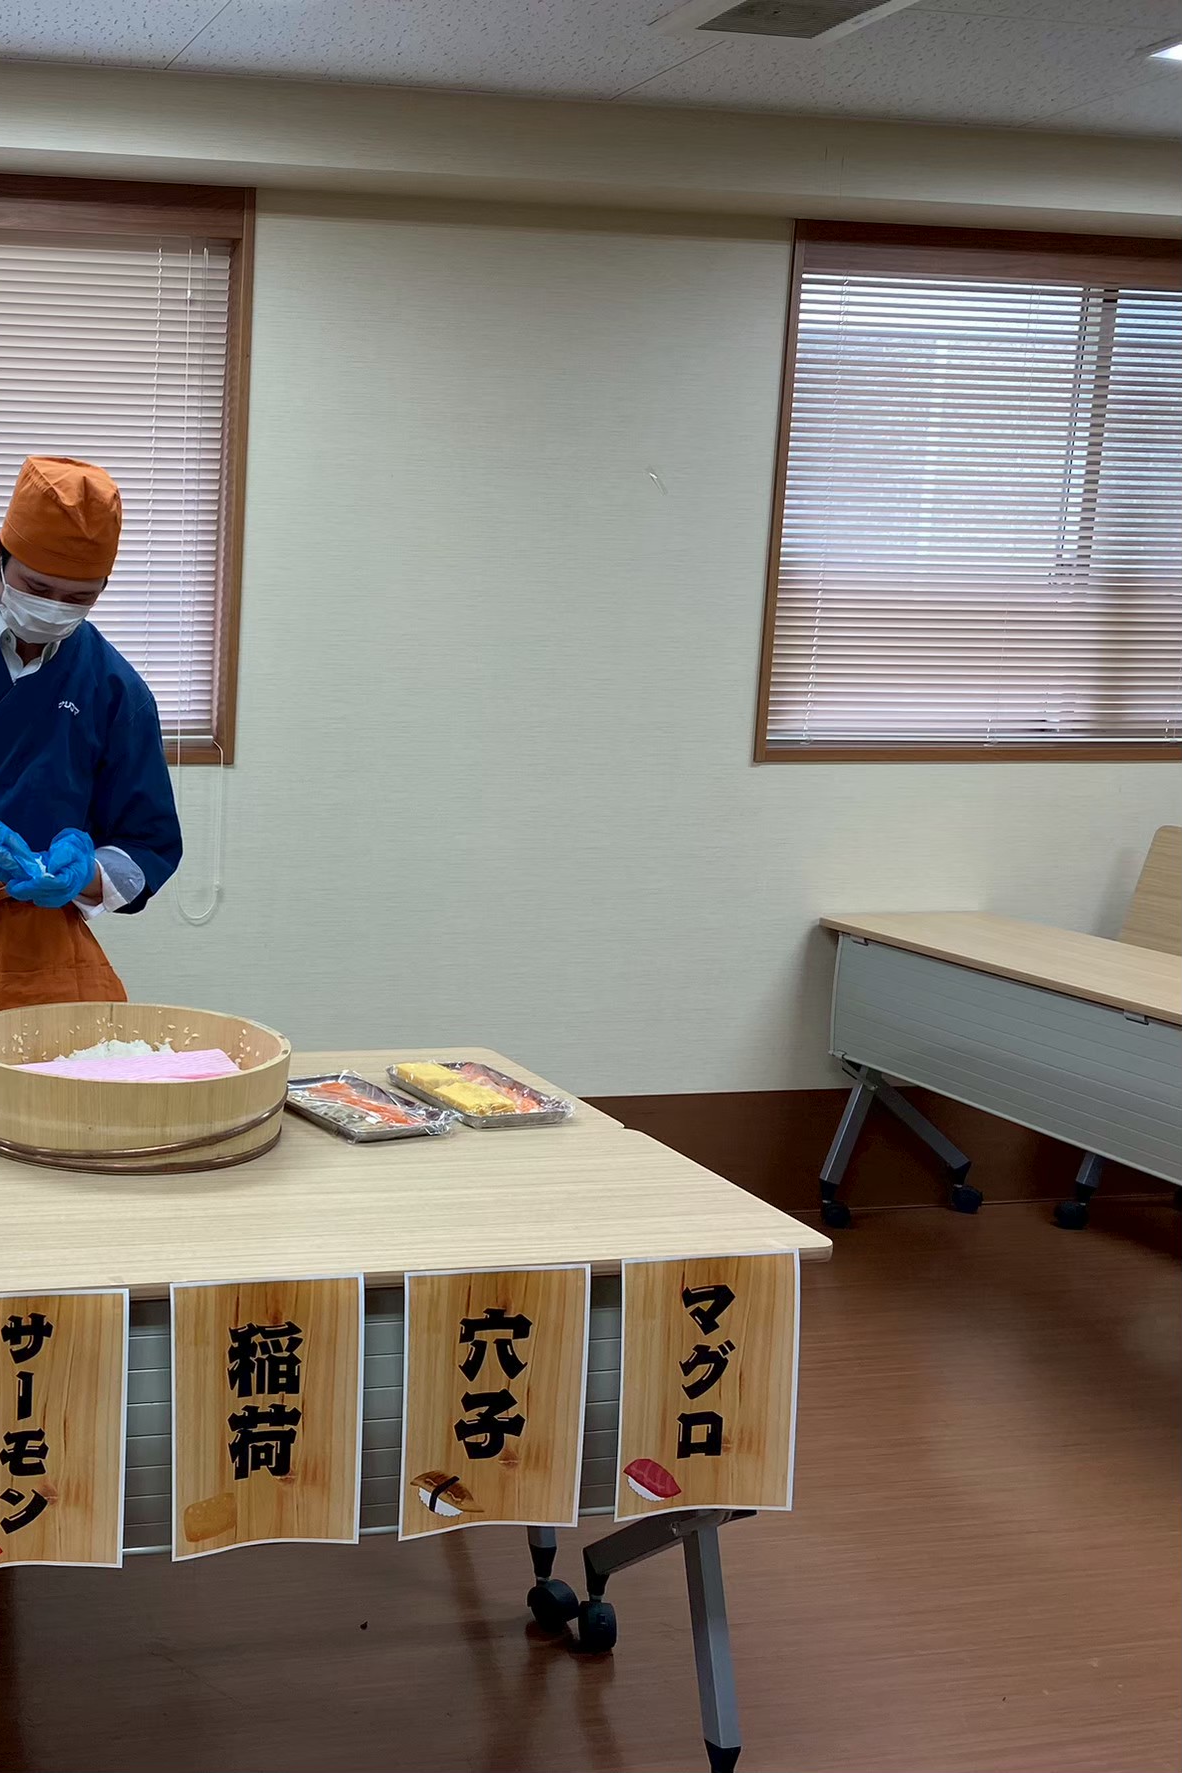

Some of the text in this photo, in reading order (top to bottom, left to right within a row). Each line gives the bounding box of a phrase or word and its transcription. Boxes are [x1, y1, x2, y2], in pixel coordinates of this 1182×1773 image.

[226, 1321, 304, 1481] 稲荷
[453, 1307, 533, 1460] 穴子
[676, 1284, 736, 1459] マグロ
